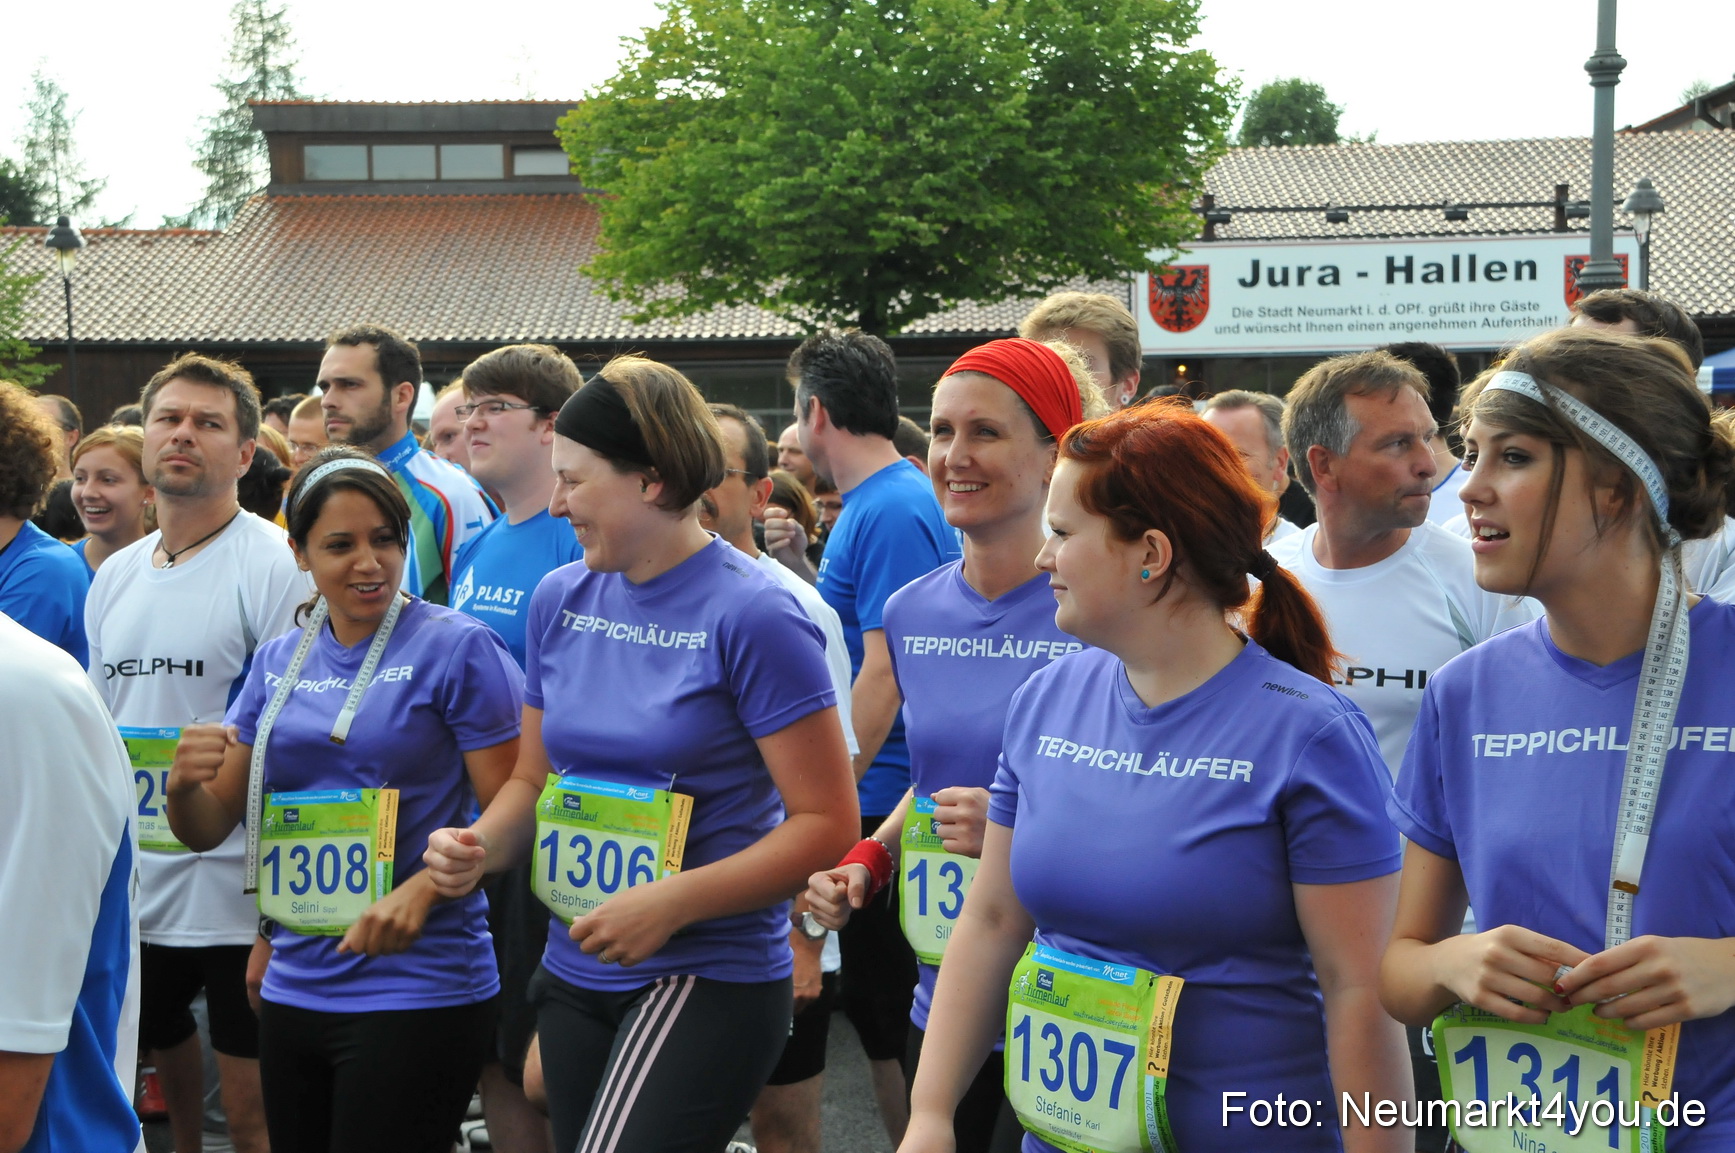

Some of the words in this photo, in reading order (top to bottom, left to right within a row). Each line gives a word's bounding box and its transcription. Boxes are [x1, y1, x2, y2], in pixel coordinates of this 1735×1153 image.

[1238, 259, 1341, 288] Jura
[1356, 271, 1369, 279] -
[1385, 253, 1538, 285] Hallen
[1232, 307, 1254, 319] Die
[1258, 306, 1294, 319] Stadt
[1297, 304, 1363, 318] Neumarkt
[1366, 305, 1374, 316] i.
[1378, 303, 1391, 316] d.
[1395, 302, 1425, 316] OPf.
[1428, 301, 1466, 317] grüßt
[1469, 300, 1496, 314] ihre
[1500, 299, 1541, 313] Gäste
[1214, 321, 1241, 336] und
[1243, 319, 1303, 335] wünscht
[1305, 319, 1344, 334] Ihnen
[1347, 319, 1386, 333] einen
[1388, 317, 1478, 334] angenehmen
[1481, 314, 1559, 330] Aufenthalt!
[1588, 421, 1599, 431] 100
[1598, 428, 1608, 438] 101
[1608, 435, 1618, 444] 102
[1617, 442, 1627, 452] 103
[476, 585, 525, 606] PLAST
[561, 609, 708, 649] TEPPICHLÄUFER
[103, 657, 204, 680] DELPHI
[1261, 680, 1310, 701] newline
[1035, 735, 1255, 783] TEPPICHLÄUFER
[553, 804, 599, 823] firmenlauf
[274, 820, 316, 833] firmenlauf
[262, 842, 369, 896] 1308
[540, 829, 656, 895] 1306
[907, 858, 975, 920] 13
[291, 901, 320, 914] Selini
[1102, 964, 1131, 981] M-net
[1027, 982, 1071, 1008] firmenlauf
[1162, 980, 1174, 1007] Gutschein
[1158, 1011, 1166, 1030] Aktion
[1154, 1034, 1164, 1059] Werbung
[1656, 1032, 1666, 1054] Aktion
[1013, 1014, 1136, 1110] 1307
[1643, 1072, 1651, 1087] Hier
[1651, 1059, 1663, 1088] Werbung
[1454, 1035, 1620, 1151] 1311
[1035, 1095, 1082, 1126] Stefanie
[1085, 1119, 1101, 1131] Karl
[1512, 1130, 1547, 1153] Nina
